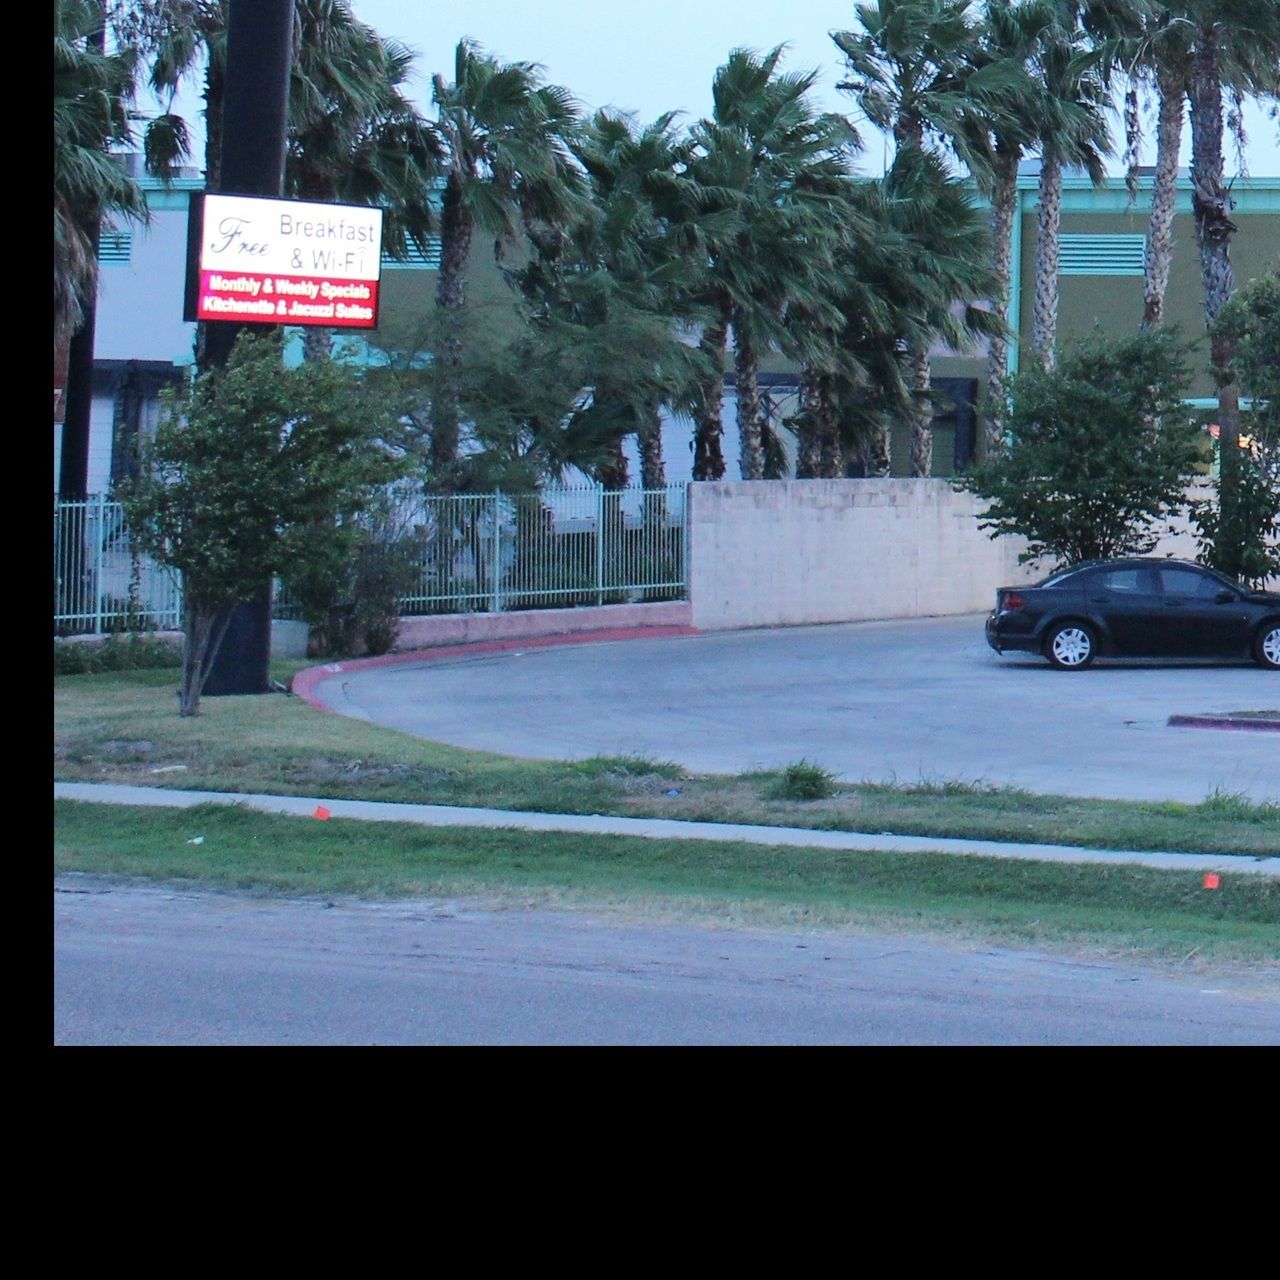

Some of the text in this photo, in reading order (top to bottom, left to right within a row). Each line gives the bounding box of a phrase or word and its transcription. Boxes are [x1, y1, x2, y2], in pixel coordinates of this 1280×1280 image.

[210, 217, 271, 256] Free
[280, 214, 375, 243] Breakfast
[290, 248, 367, 273] & Wi-Fi
[209, 275, 371, 301] Monthly & Weekly Specials
[276, 299, 288, 315] &
[288, 299, 334, 317] Jacuzzi
[335, 302, 373, 320] Suites
